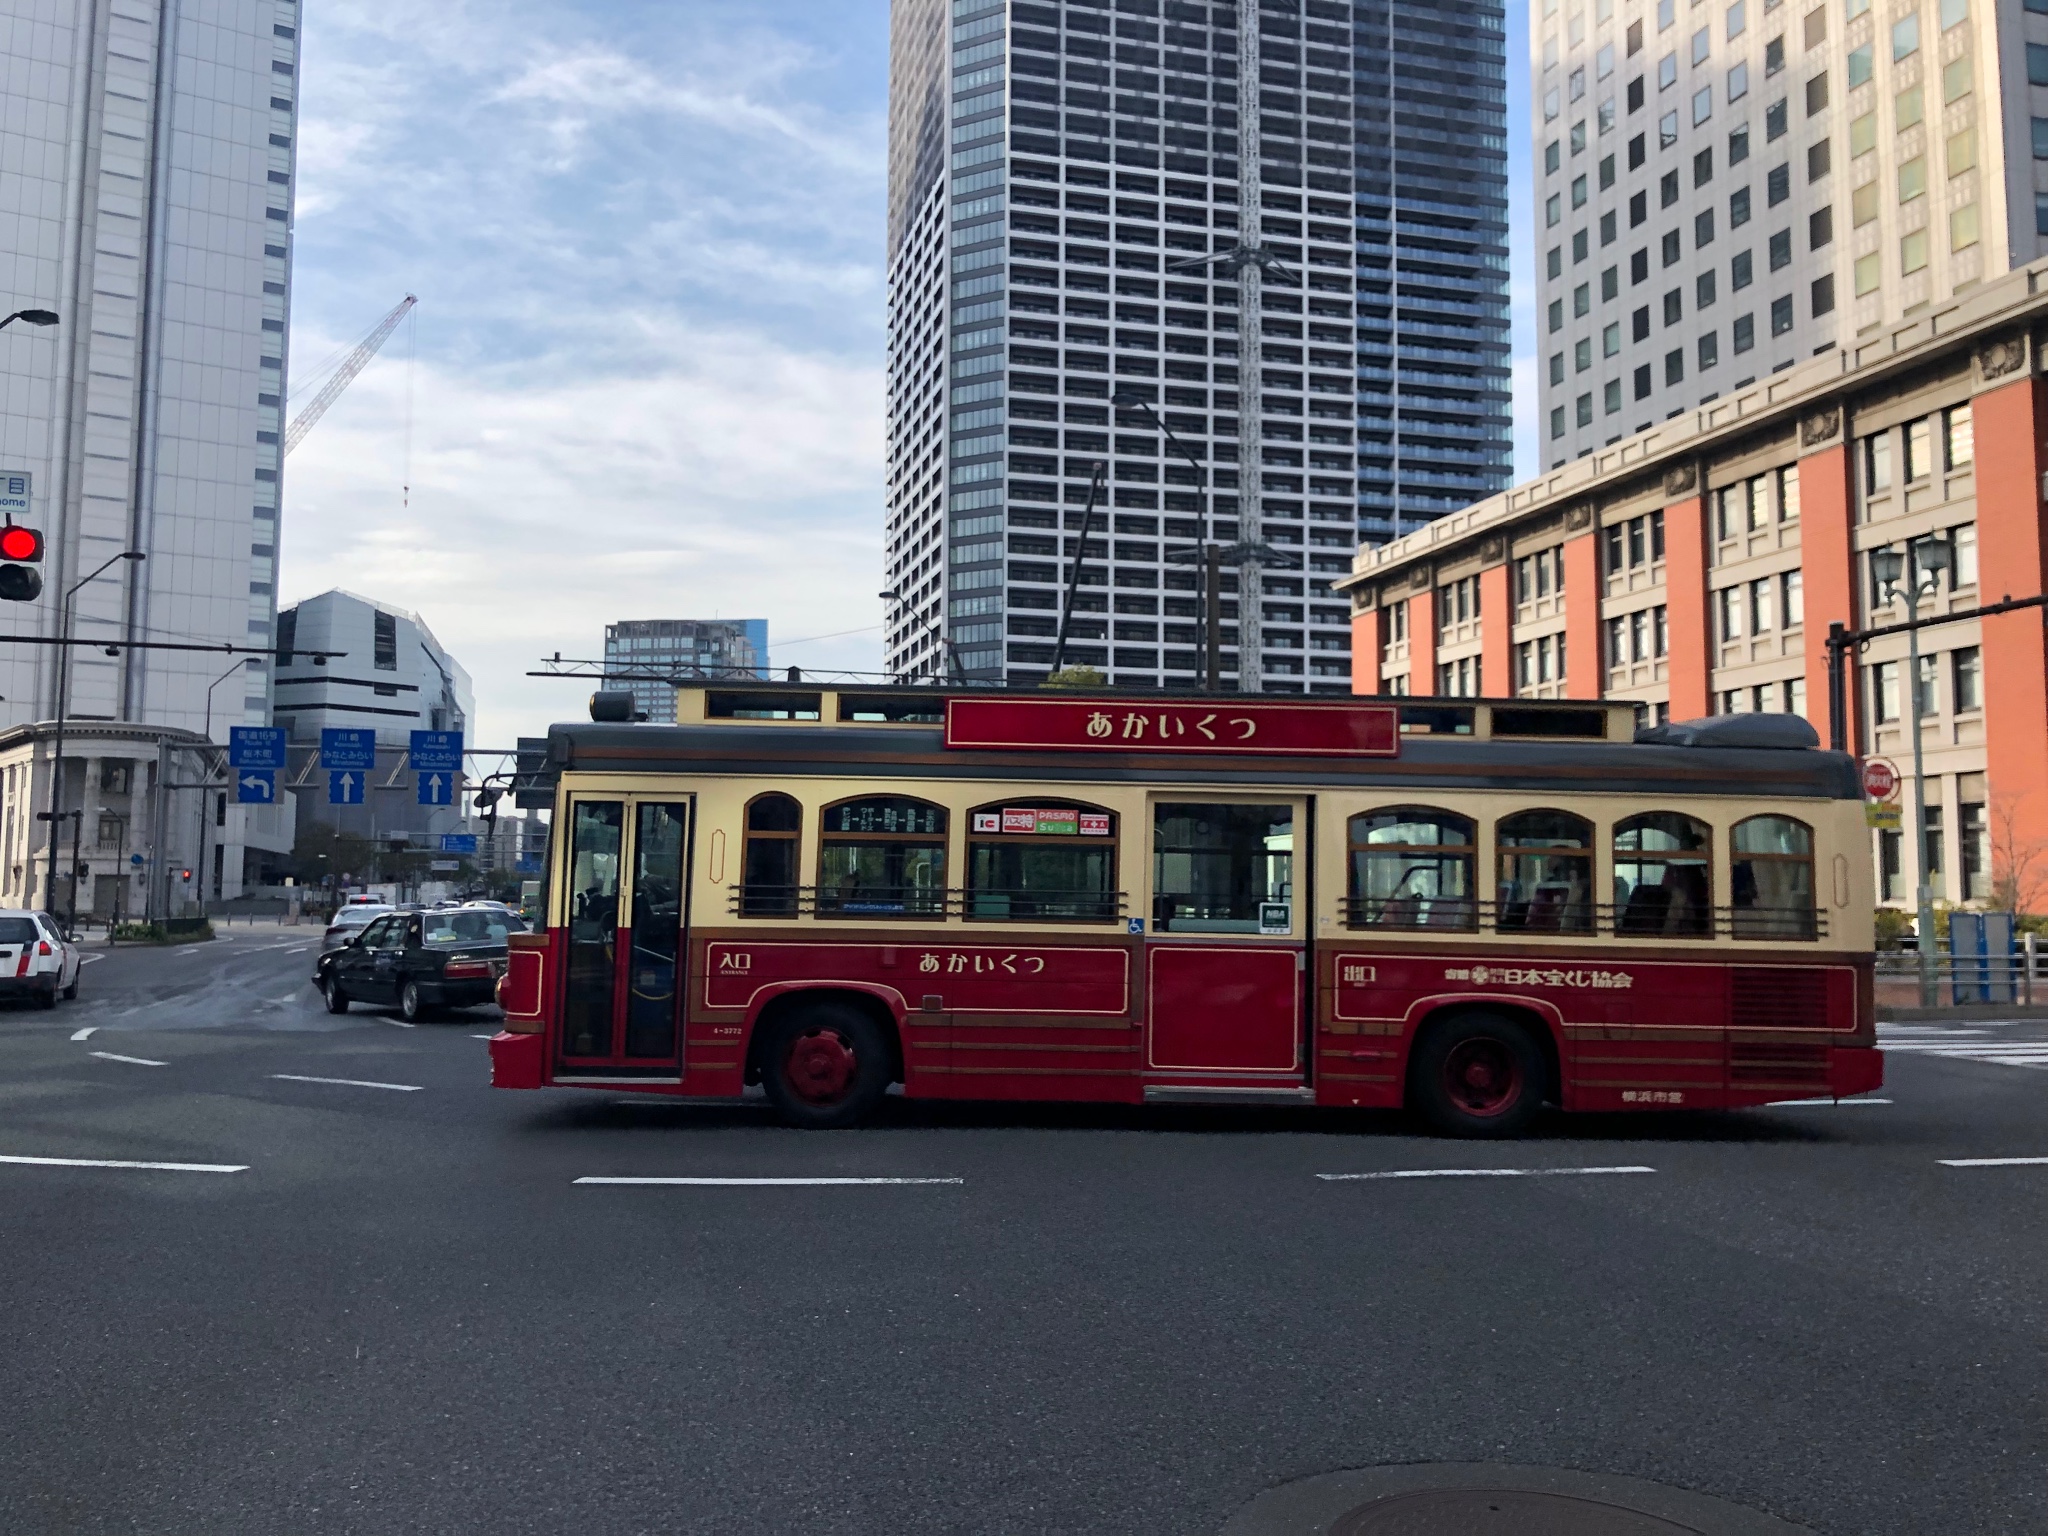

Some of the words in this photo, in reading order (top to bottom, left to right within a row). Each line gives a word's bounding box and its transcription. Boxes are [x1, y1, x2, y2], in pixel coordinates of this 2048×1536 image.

[0, 477, 24, 494] 目
[0, 498, 26, 507] ome
[1086, 711, 1257, 741] あかいくつ
[323, 750, 373, 760] みなとみらい
[411, 752, 461, 762] みなとみらい
[719, 952, 751, 969] 入口
[919, 953, 1045, 974] あかいくつ
[1343, 965, 1376, 982] 出口
[1504, 968, 1634, 989] 日本宝くじ協会
